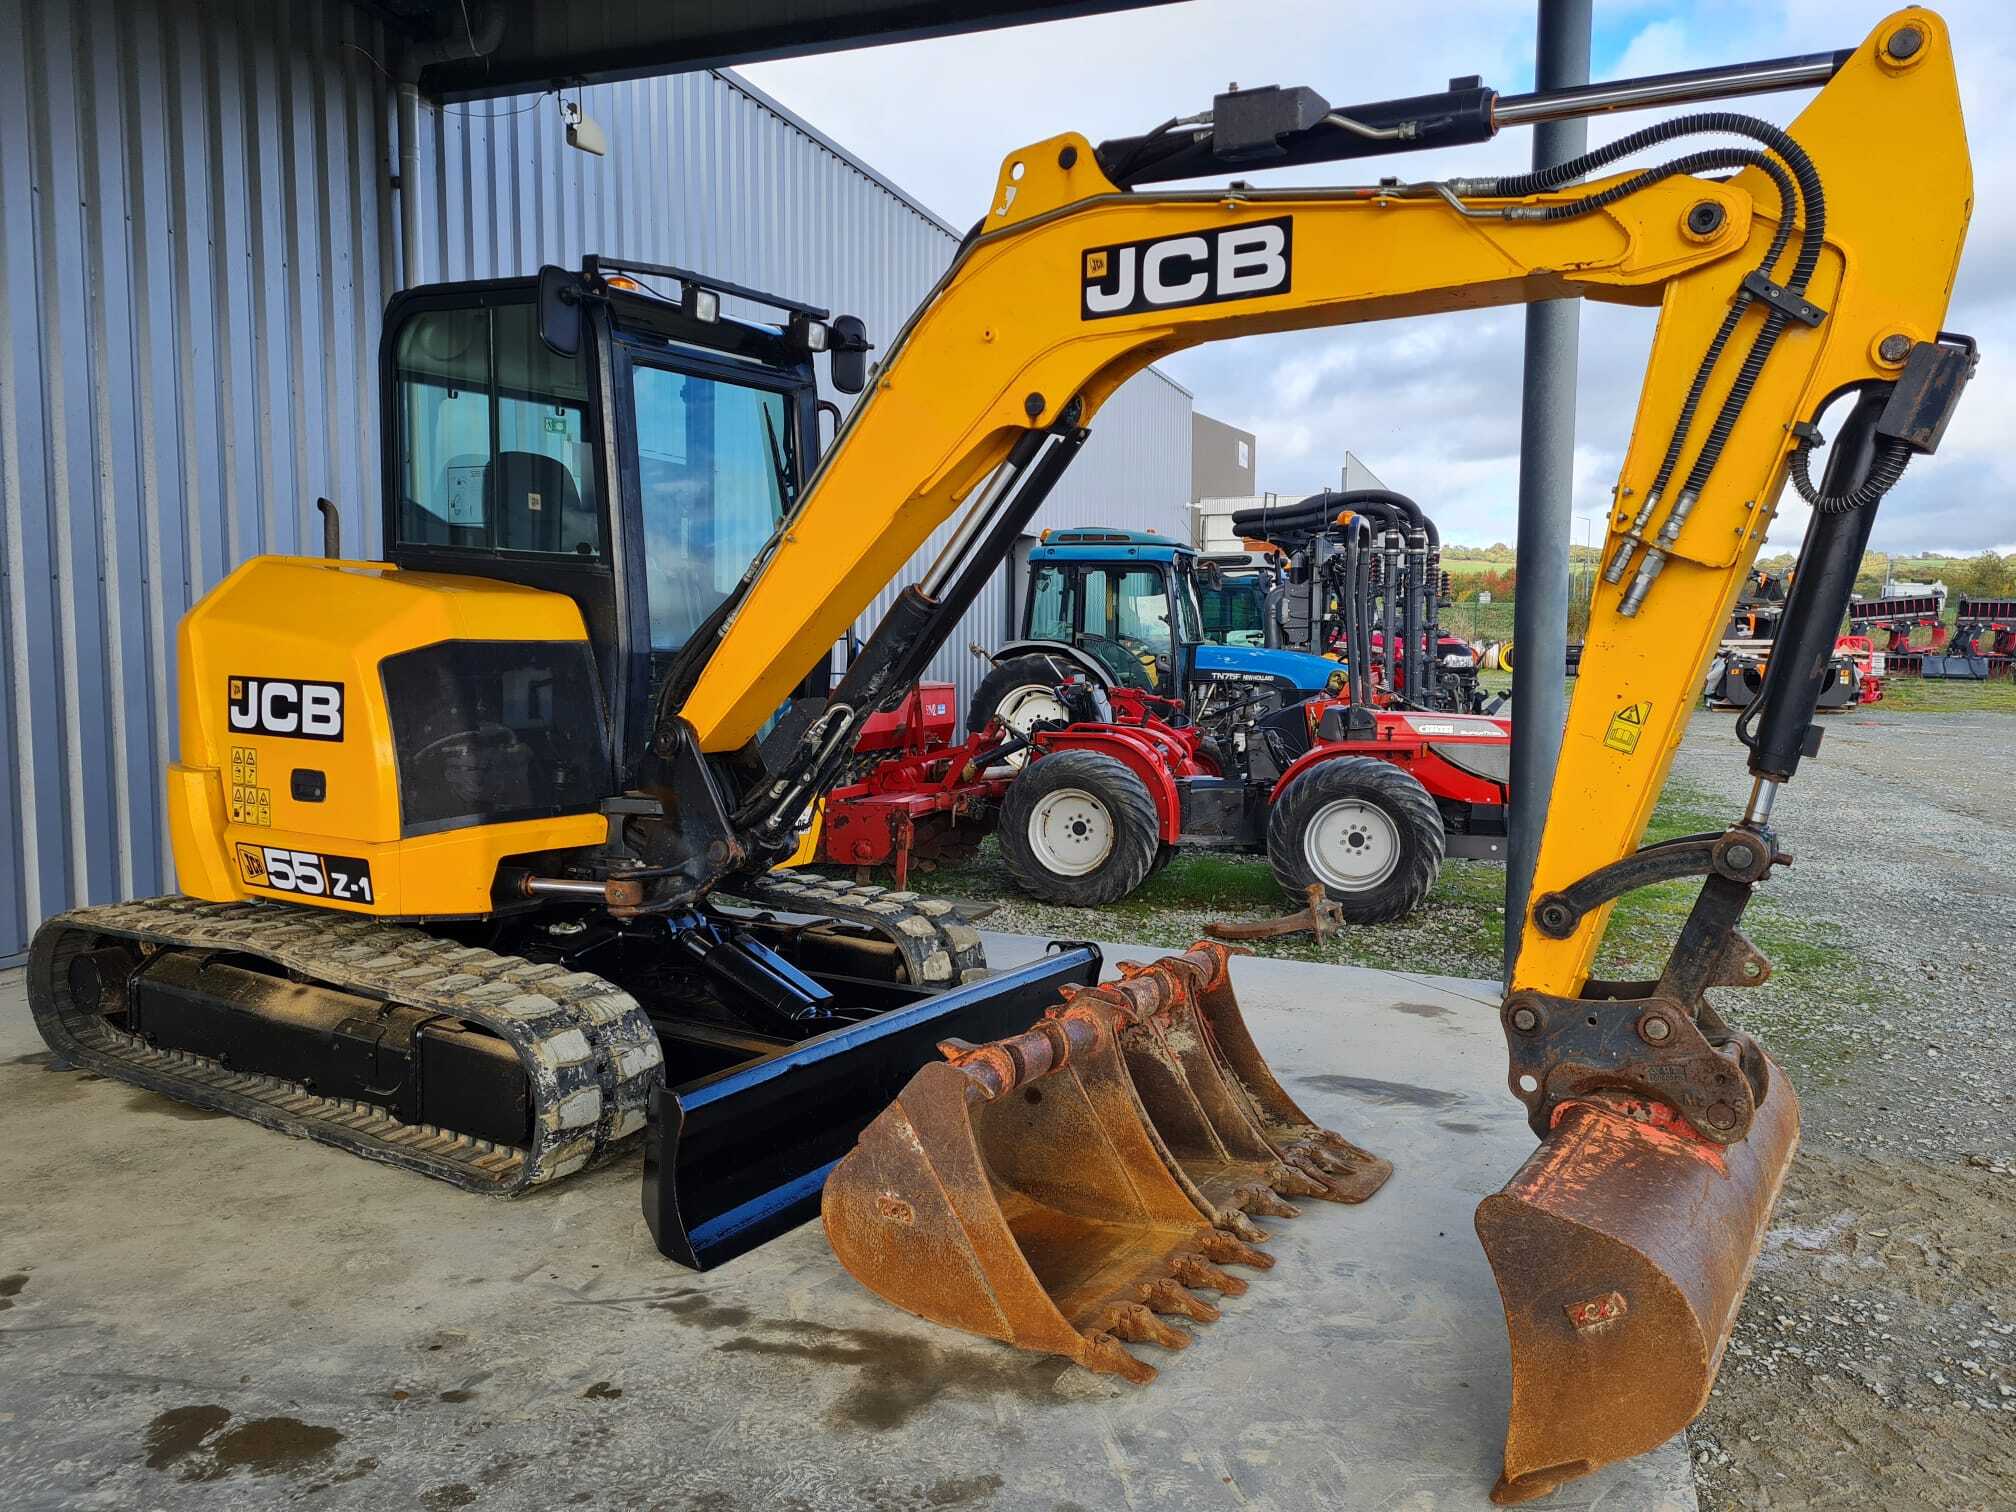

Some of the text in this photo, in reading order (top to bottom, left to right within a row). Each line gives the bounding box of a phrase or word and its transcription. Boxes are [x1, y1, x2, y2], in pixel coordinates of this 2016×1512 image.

[1086, 225, 1286, 312] JCB
[231, 681, 341, 735] JCB
[264, 848, 324, 894] 55
